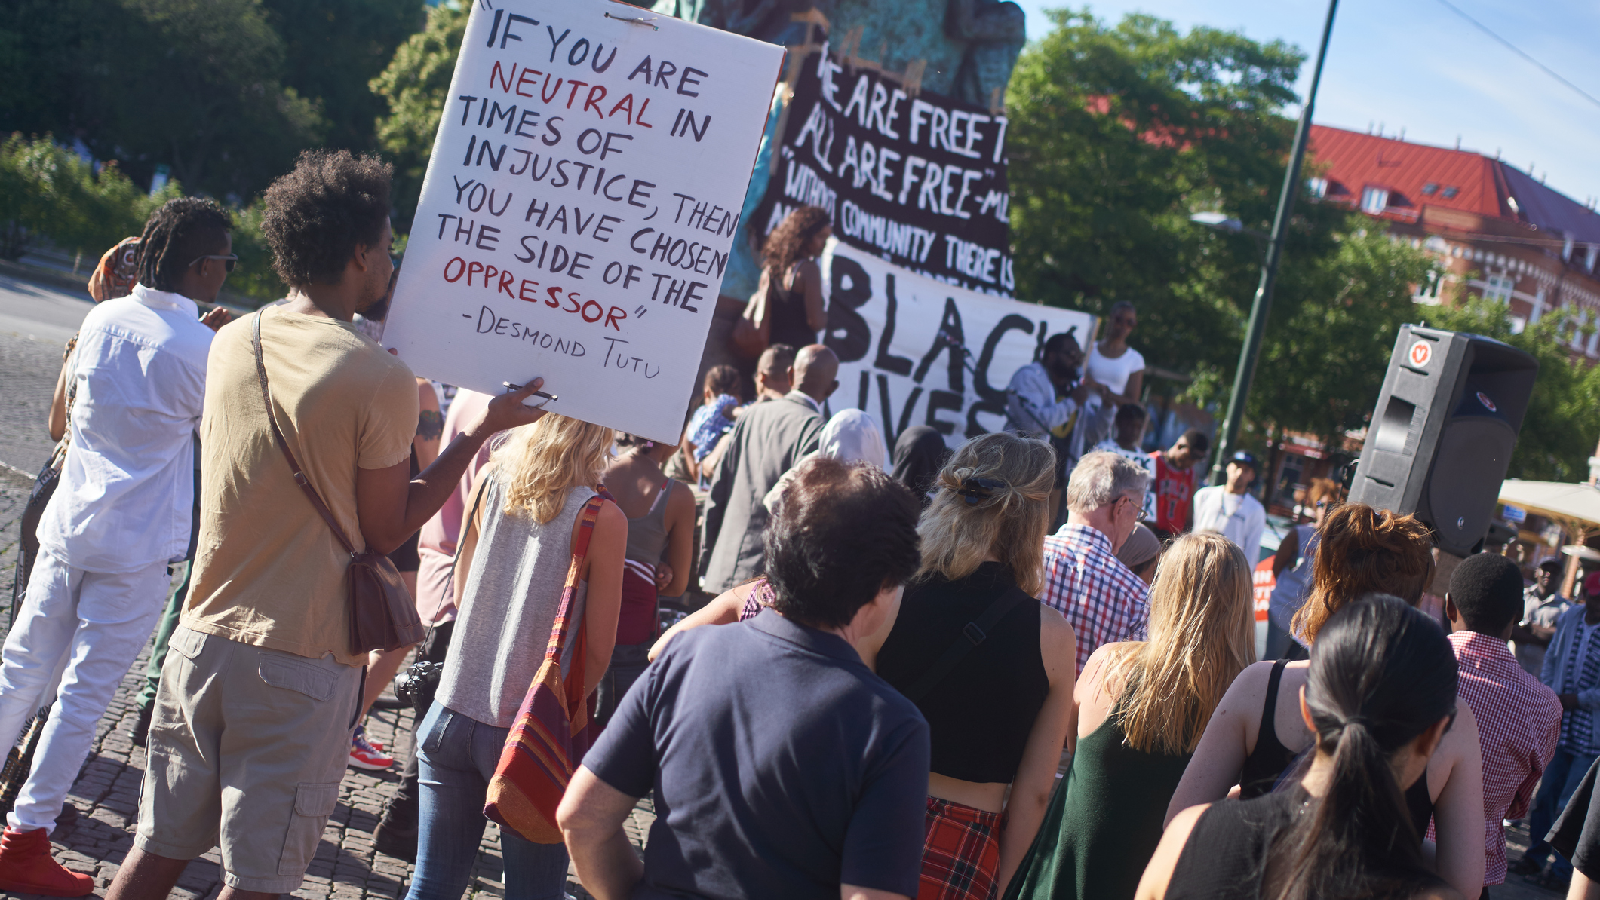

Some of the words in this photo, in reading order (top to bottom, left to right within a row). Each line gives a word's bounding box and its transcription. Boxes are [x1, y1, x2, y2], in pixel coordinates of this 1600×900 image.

[489, 60, 653, 129] NEUTRAL
[670, 108, 712, 142] IN
[547, 25, 617, 74] YOU
[627, 54, 709, 98] ARE
[458, 95, 564, 146] TIMES
[576, 127, 635, 161] OF
[794, 102, 834, 173] ALL
[838, 136, 902, 201] ARE
[843, 74, 908, 139] ARE
[909, 99, 991, 159] FREE
[452, 175, 513, 217] YOU
[525, 198, 626, 242] HAVE
[630, 228, 729, 280] CHOSEN
[673, 192, 742, 239] THEN
[841, 200, 937, 264] COMMUNITY
[945, 234, 1001, 284] THERE
[1000, 253, 1016, 292] IS
[437, 213, 501, 252] THE
[514, 235, 594, 280] SIDE
[602, 261, 643, 290] OF
[651, 273, 709, 313] THE
